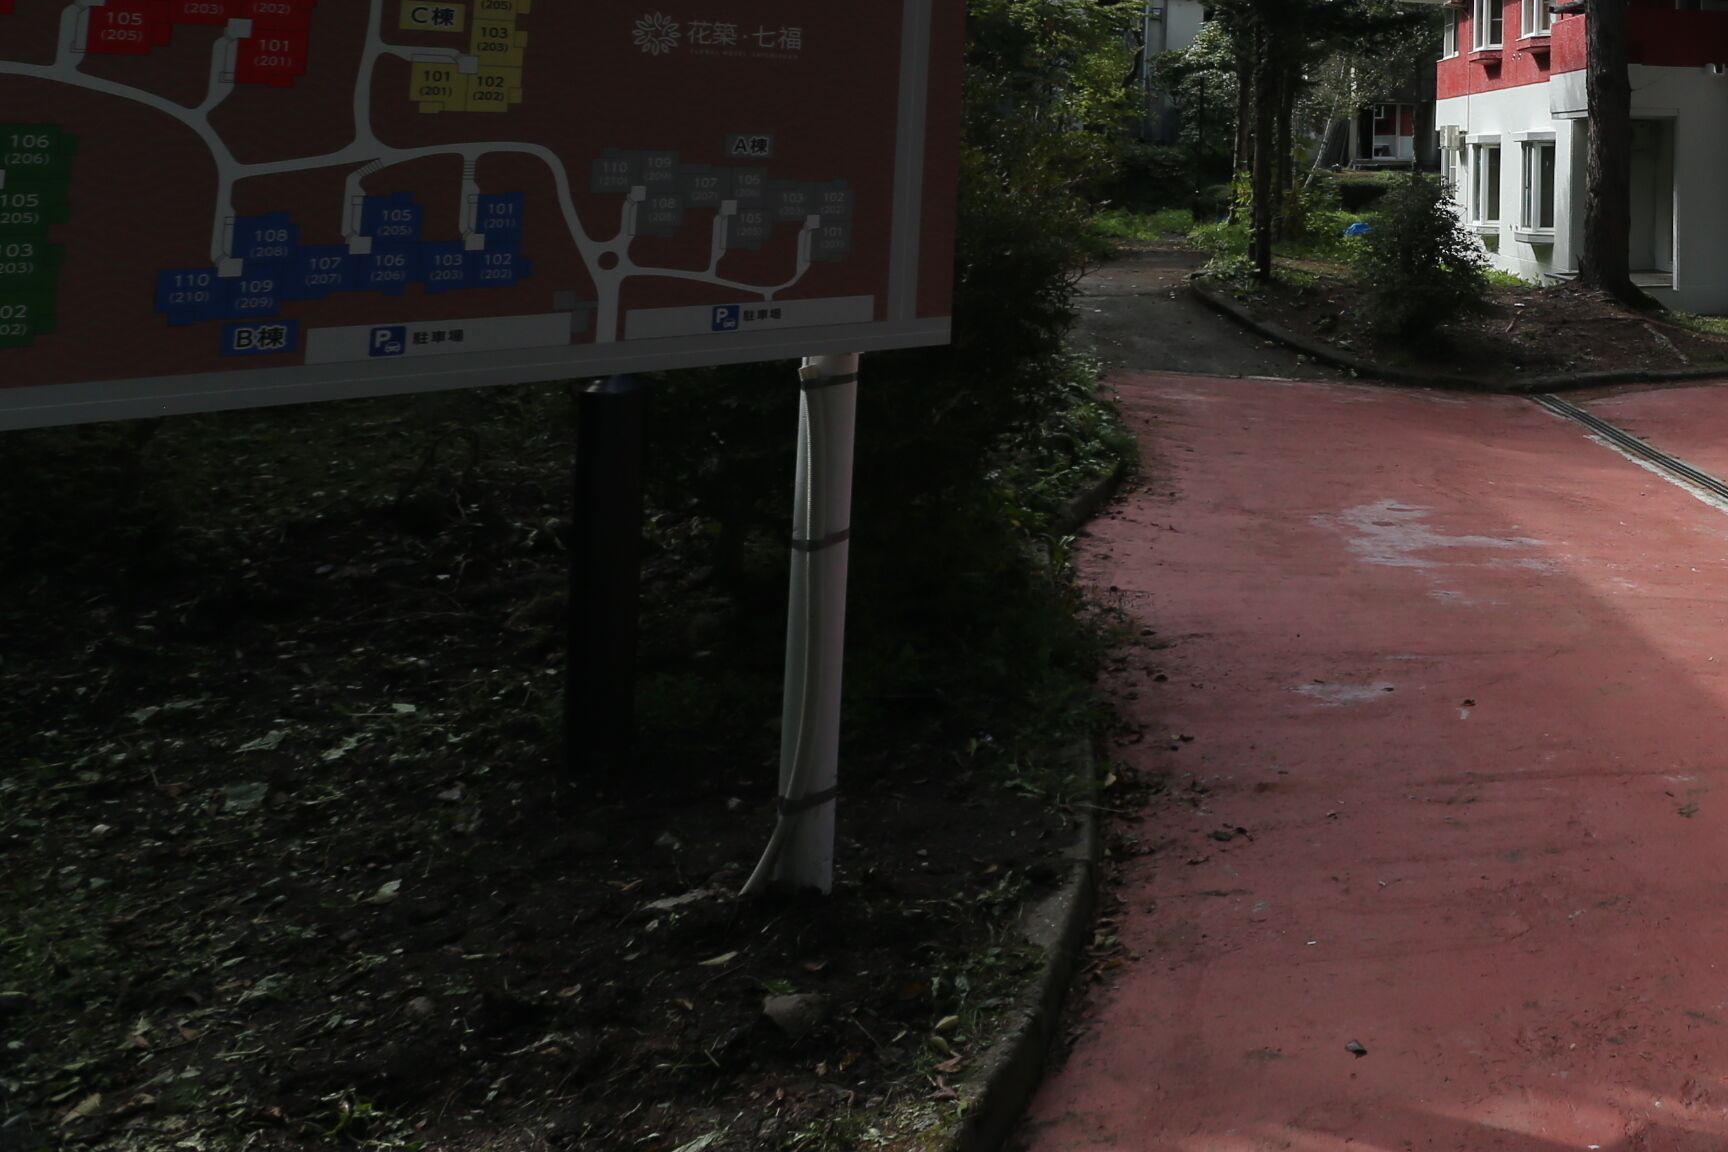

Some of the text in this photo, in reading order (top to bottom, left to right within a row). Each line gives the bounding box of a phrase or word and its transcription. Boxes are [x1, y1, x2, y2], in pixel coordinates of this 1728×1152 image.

[183, 1, 225, 17] (203)
[251, 1, 292, 17] (202)
[411, 6, 456, 27] C棟
[105, 11, 144, 27] 105
[100, 28, 145, 43] (205)
[481, 26, 509, 39] 103
[258, 38, 291, 54] 101
[252, 54, 294, 69] (201)
[423, 70, 451, 83] 101
[476, 76, 505, 88] 102
[11, 134, 51, 149] 106
[733, 137, 769, 154] A棟
[3, 152, 51, 166] (206)
[694, 177, 718, 188] 107
[381, 208, 413, 222] 105
[488, 202, 513, 215] 101
[0, 212, 40, 225] 205)
[254, 228, 289, 242] 108
[0, 243, 35, 258] 03
[309, 256, 343, 271] 107
[375, 253, 406, 267] 106
[433, 253, 464, 266] 103
[483, 252, 512, 265] 102
[0, 262, 35, 275] 203)
[173, 273, 211, 287] 110
[239, 279, 275, 294] 109
[0, 304, 28, 319] 02
[716, 308, 729, 323] P
[0, 323, 28, 337] 02)
[235, 326, 286, 348] B棟
[412, 328, 464, 345] 駐車場
[375, 329, 392, 347] P
